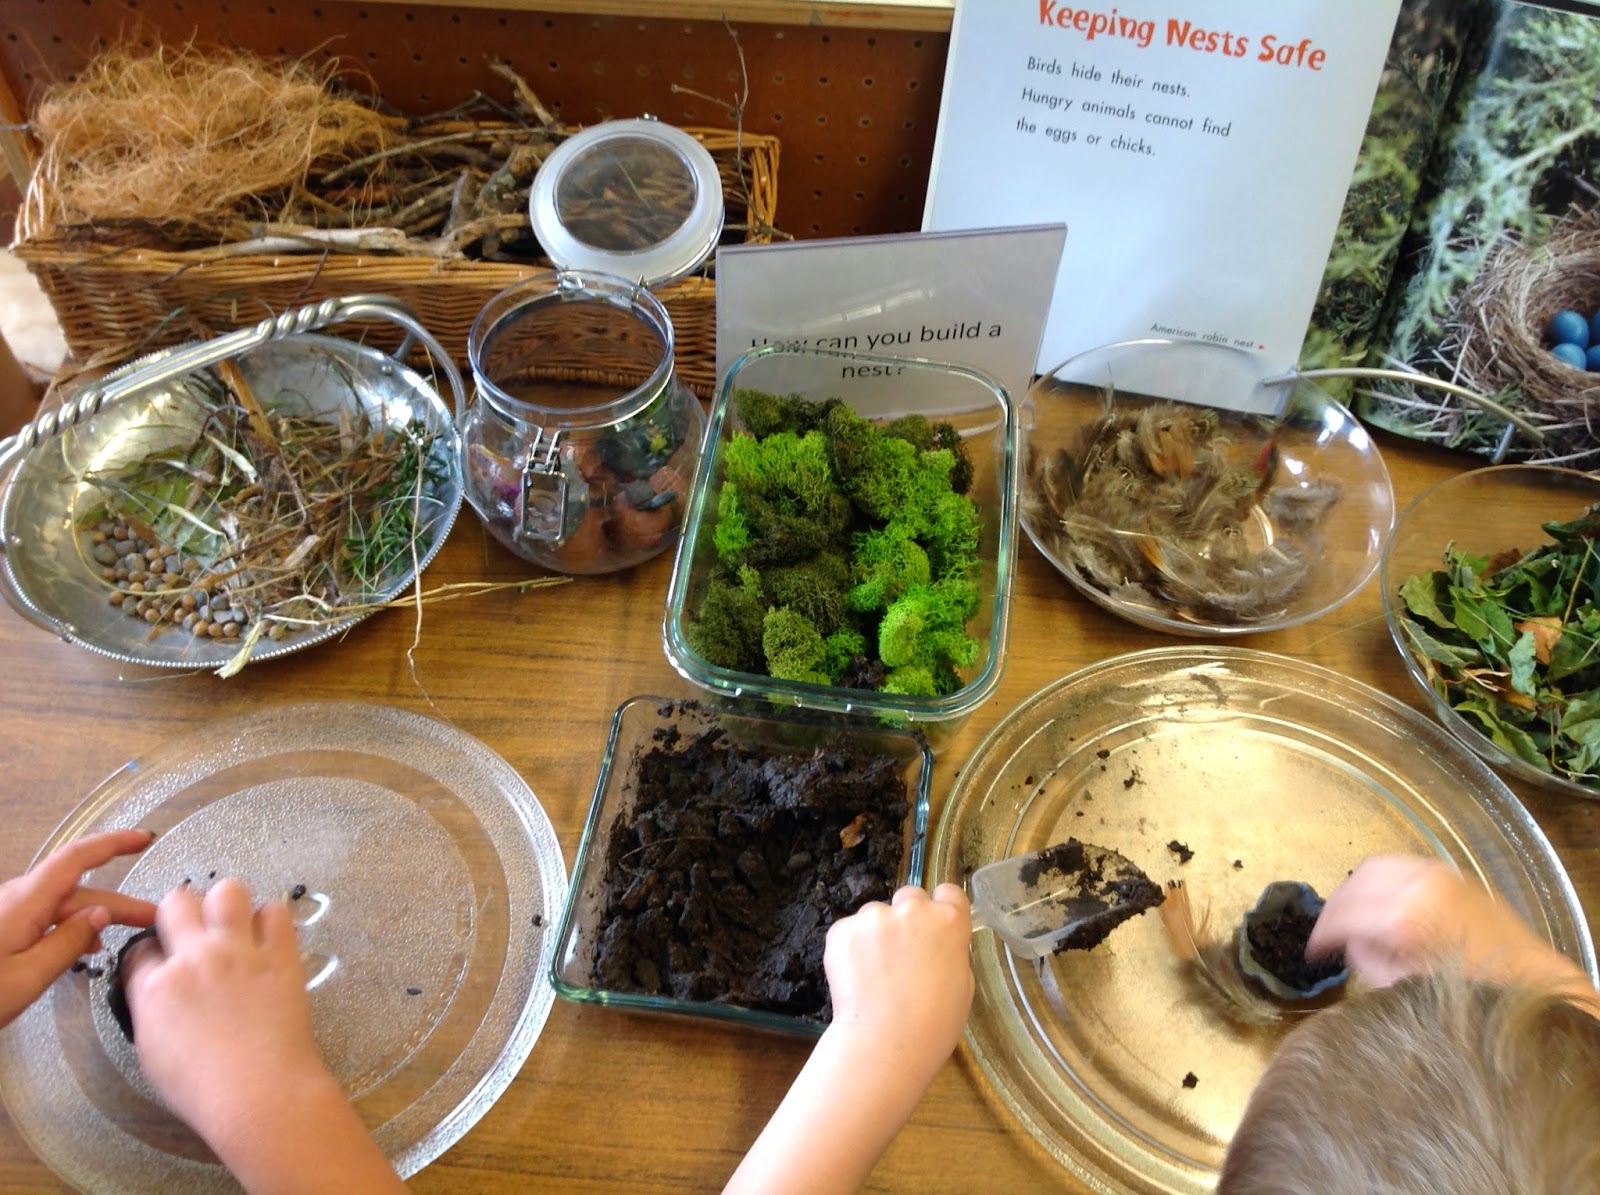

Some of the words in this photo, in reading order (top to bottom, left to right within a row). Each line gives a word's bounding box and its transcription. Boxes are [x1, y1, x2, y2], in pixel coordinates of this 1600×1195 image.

[1038, 0, 1155, 48] Keeping
[1166, 18, 1248, 58] Nests
[1257, 34, 1326, 71] Safe
[1027, 56, 1062, 76] Birds
[1070, 61, 1102, 82] hide
[1110, 69, 1144, 89] their
[1151, 81, 1190, 98] nests.
[1021, 87, 1073, 112] Hungry
[1081, 99, 1136, 121] animals
[1145, 110, 1193, 131] cannot
[1202, 118, 1232, 138] find
[1016, 117, 1037, 134] the
[1045, 126, 1077, 143] eggs
[1086, 134, 1102, 146] or
[1110, 135, 1156, 156] chicks.
[816, 335, 858, 349] can
[867, 330, 911, 350] you
[920, 321, 981, 343] build
[988, 323, 1002, 338] a
[1150, 323, 1197, 338] American
[1202, 332, 1228, 344] robin
[1234, 338, 1254, 348] nest
